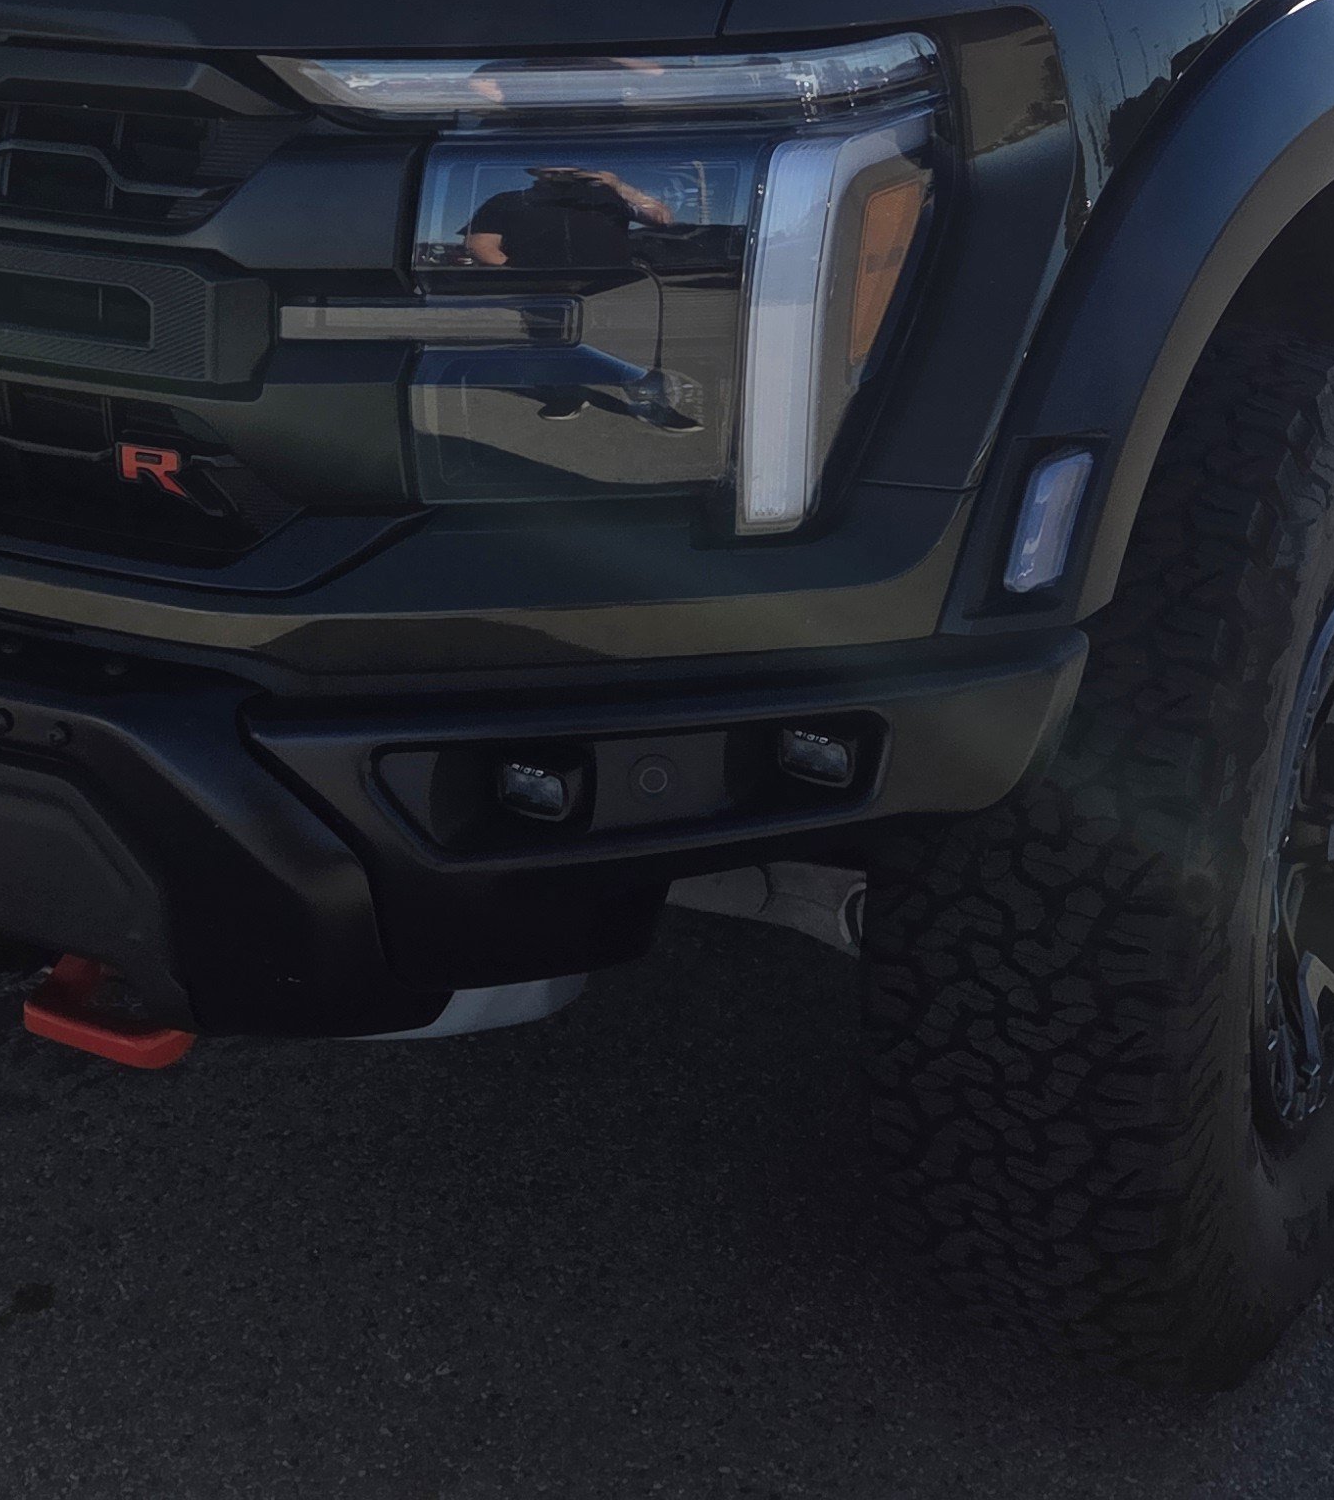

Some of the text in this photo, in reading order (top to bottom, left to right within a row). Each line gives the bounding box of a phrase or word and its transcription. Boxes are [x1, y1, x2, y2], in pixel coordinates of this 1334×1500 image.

[121, 443, 189, 497] R
[794, 730, 829, 744] RIGID
[511, 763, 545, 777] RIGID
